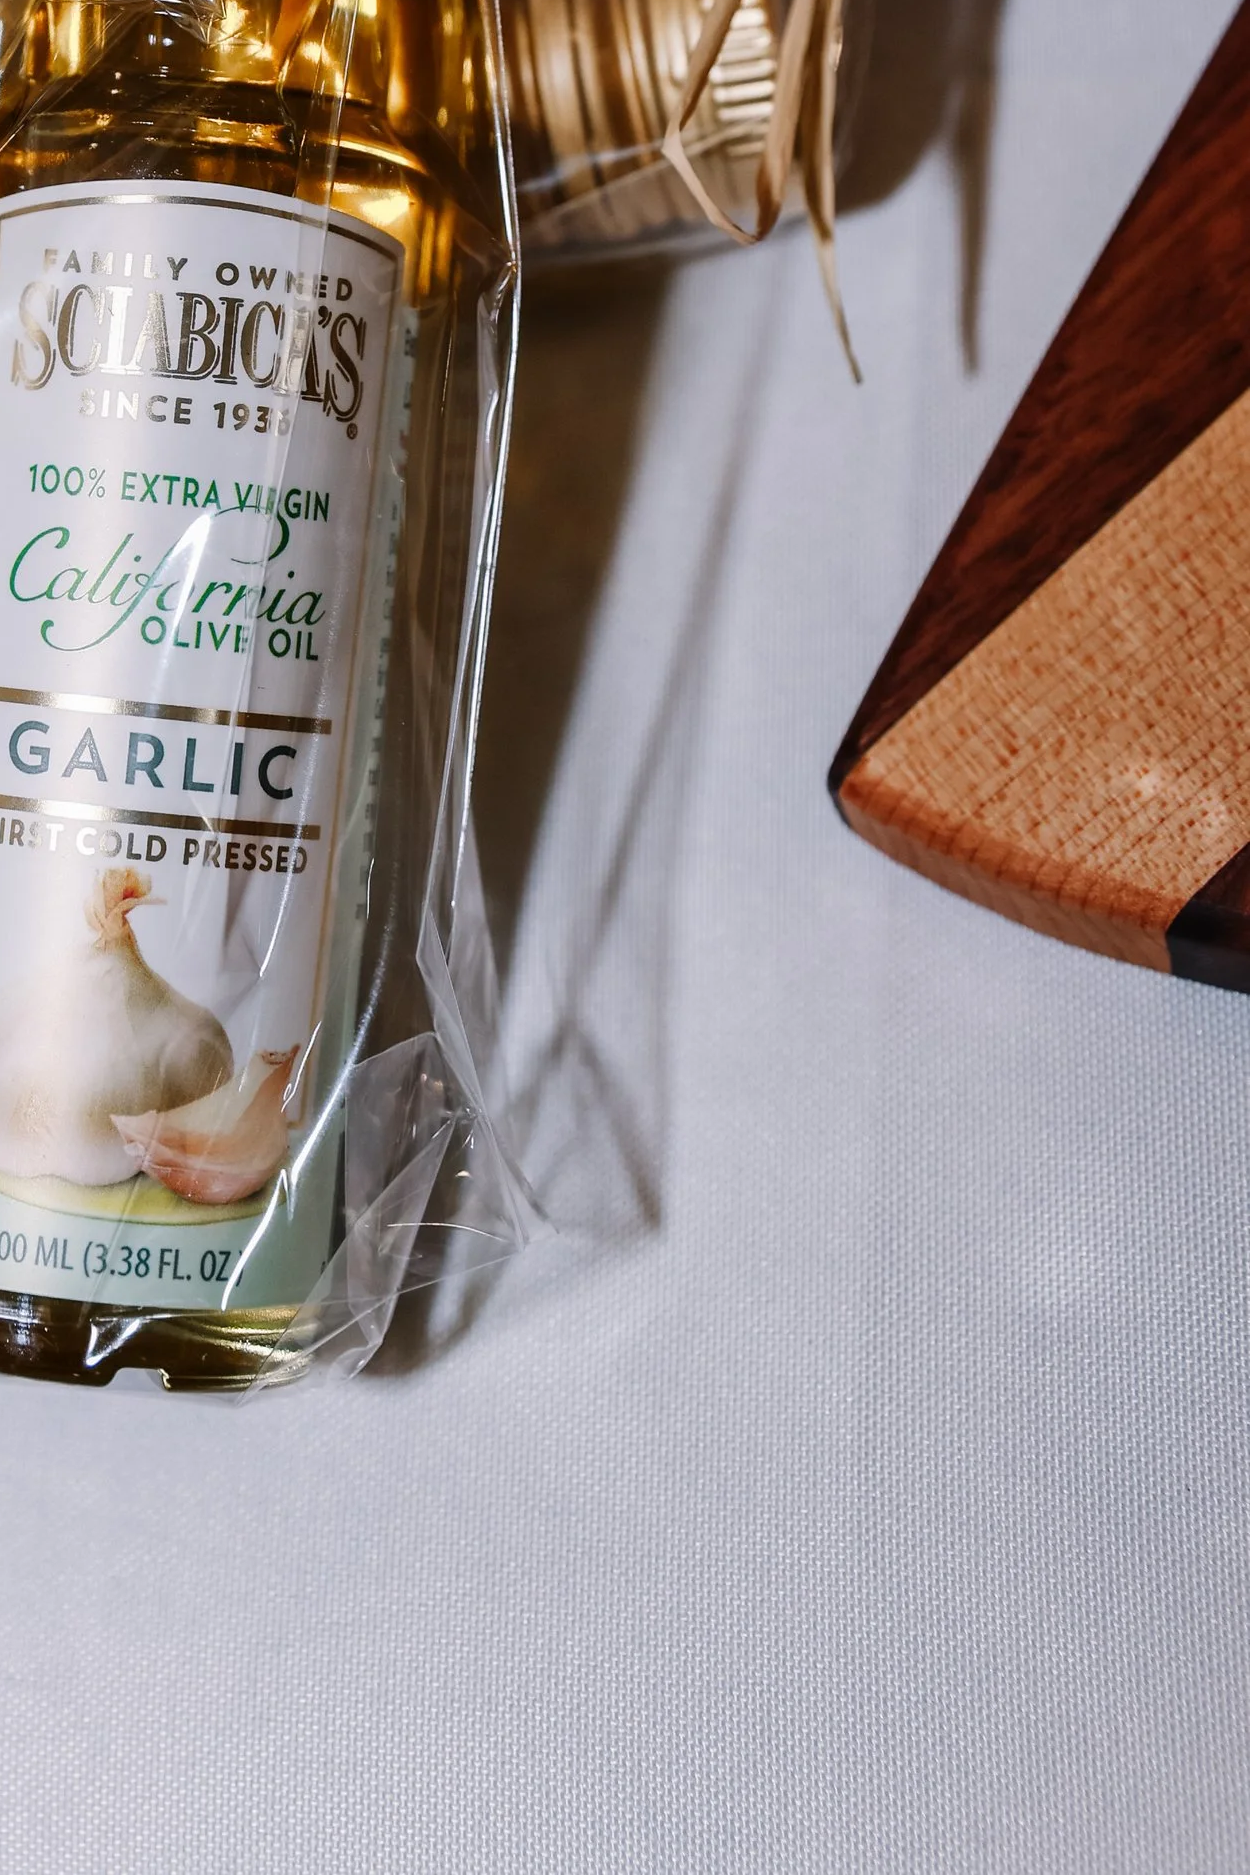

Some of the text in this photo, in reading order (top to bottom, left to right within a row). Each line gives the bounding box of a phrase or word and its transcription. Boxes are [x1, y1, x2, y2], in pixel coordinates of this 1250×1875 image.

[44, 248, 353, 302] FAMILY OWNED
[78, 388, 291, 437] SINCE 1936
[29, 464, 331, 523] 100% EXTRA VIRGIN
[8, 525, 327, 653] California
[140, 615, 320, 662] OLIVE OIL
[8, 720, 298, 801] GARLIC
[74, 825, 168, 863] COLD
[182, 837, 309, 875] PRESSED
[34, 1235, 75, 1271] ML
[82, 1240, 151, 1278] (3.38
[157, 1247, 193, 1281] FL.
[199, 1248, 246, 1288] OZ)
